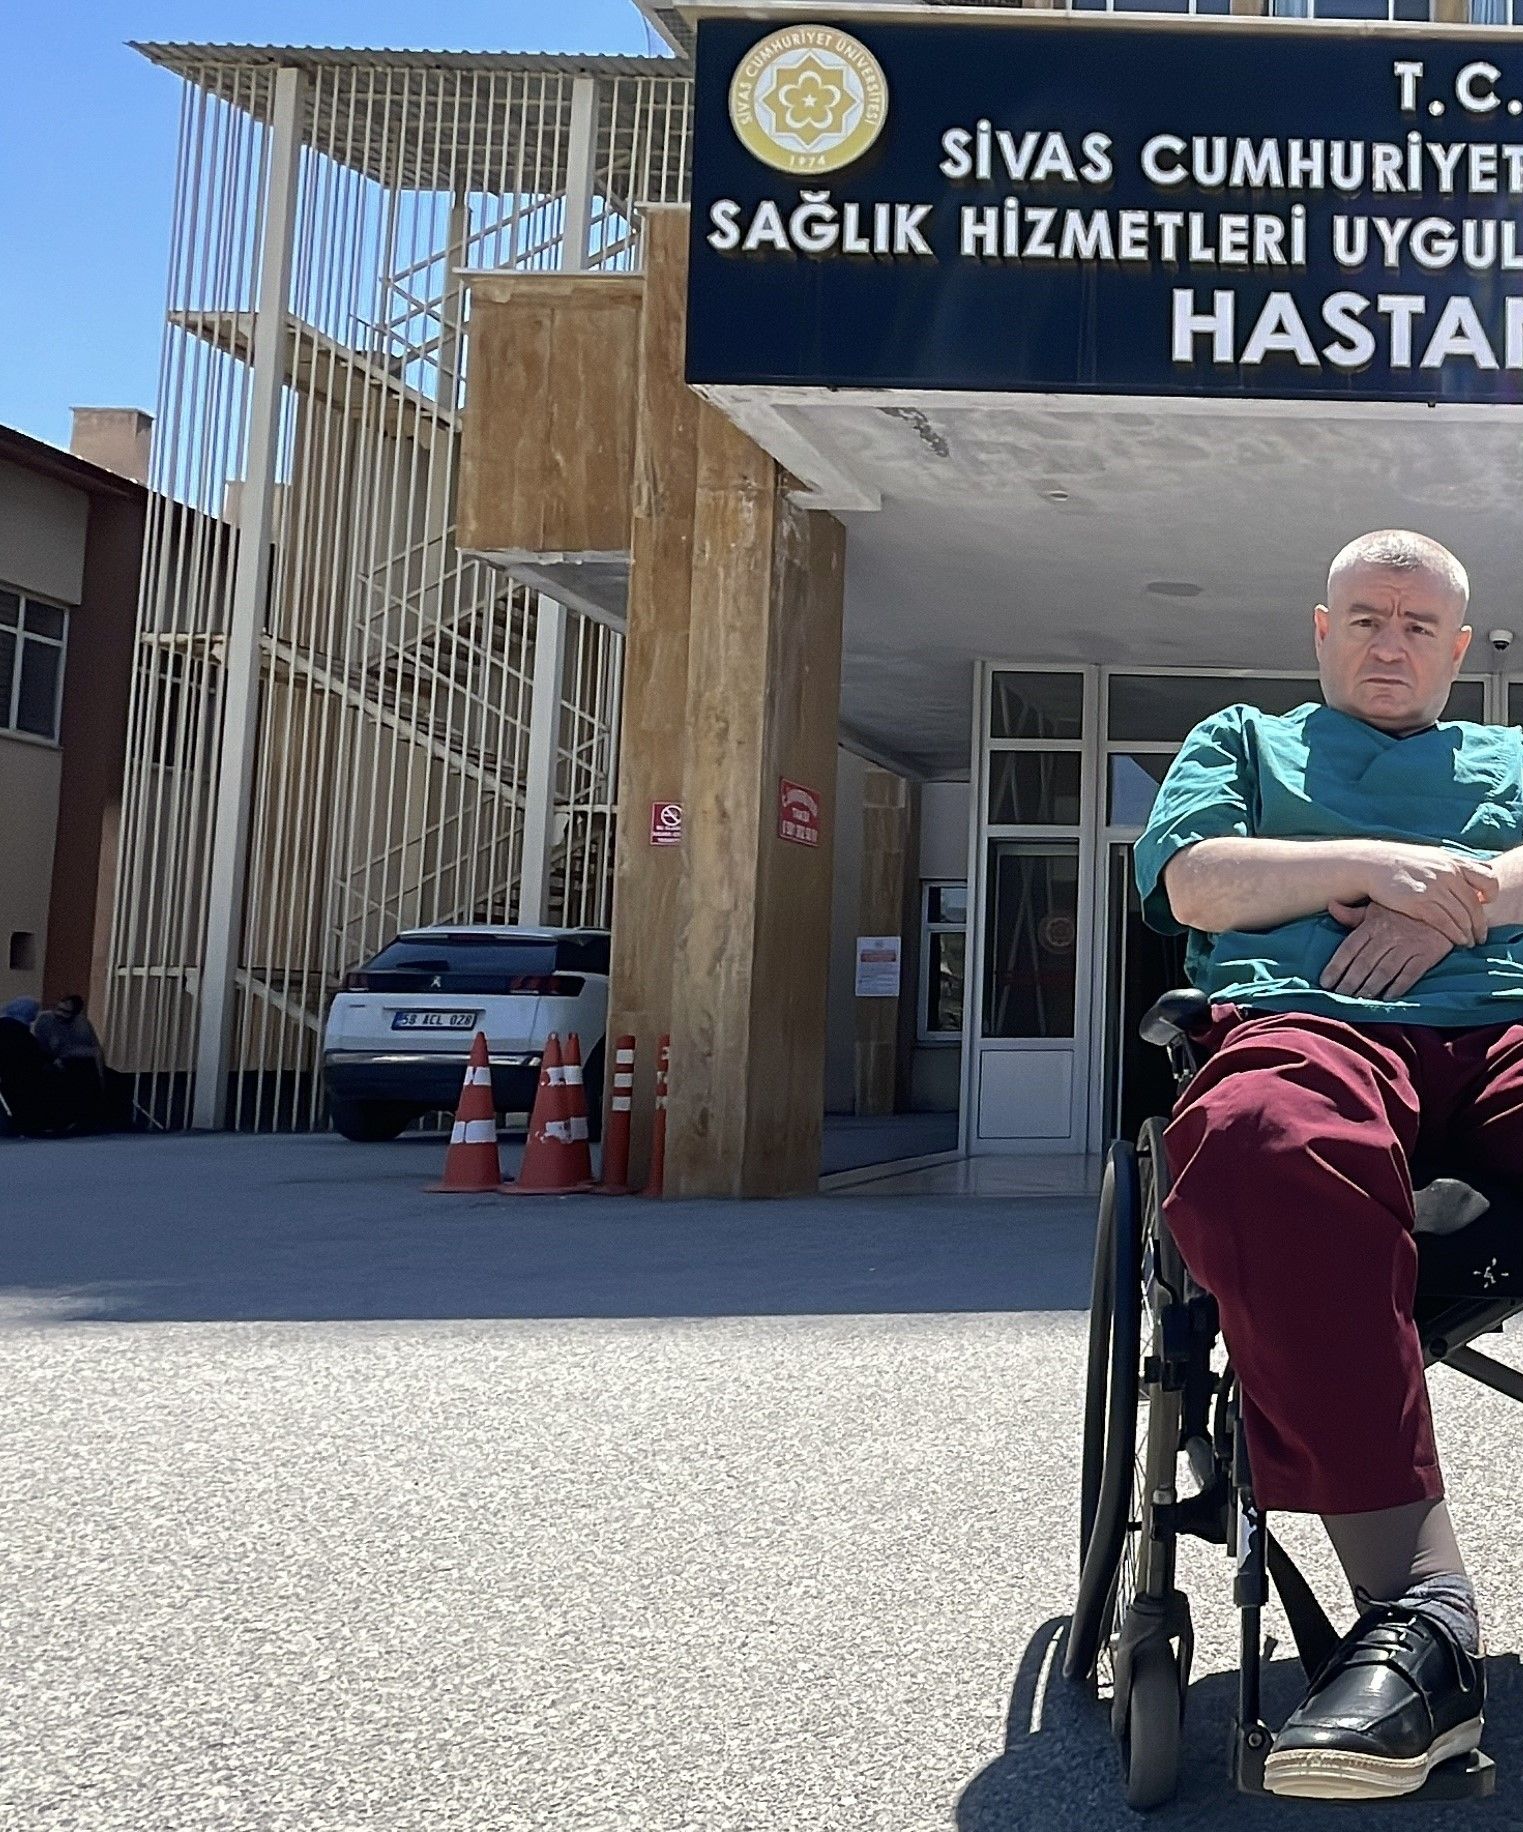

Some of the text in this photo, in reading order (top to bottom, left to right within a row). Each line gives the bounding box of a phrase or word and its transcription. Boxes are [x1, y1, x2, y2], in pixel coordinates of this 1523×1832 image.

[1393, 61, 1523, 116] T.C.
[939, 119, 1113, 183] SİVAS
[706, 190, 934, 255] SAĞLIK
[961, 196, 1306, 266] HİZMETLERİ
